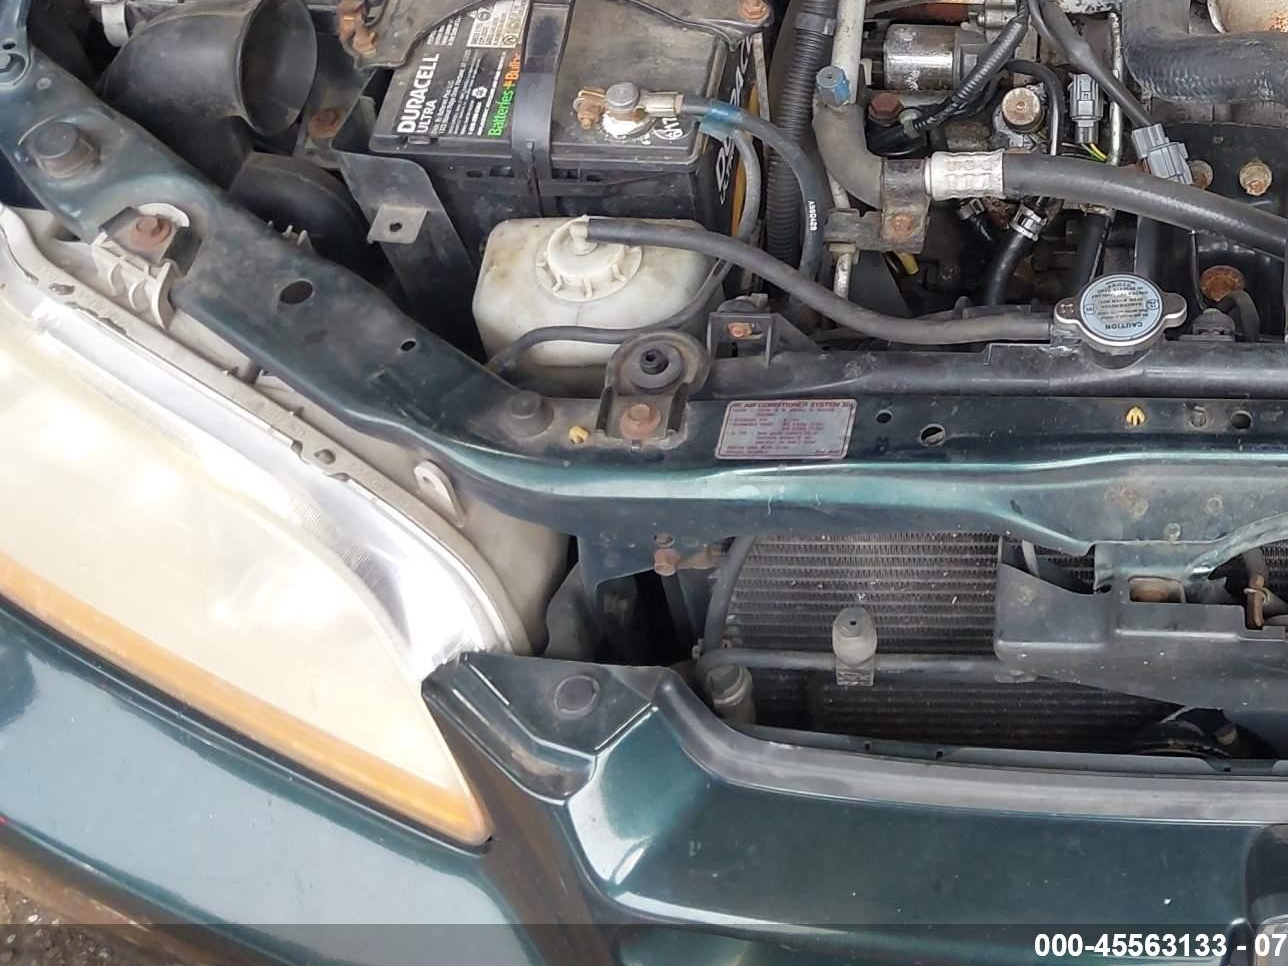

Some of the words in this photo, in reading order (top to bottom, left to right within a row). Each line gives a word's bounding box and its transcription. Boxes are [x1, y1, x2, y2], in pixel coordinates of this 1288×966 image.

[397, 53, 440, 133] DURACELL
[416, 99, 437, 133] ULTRA
[1105, 321, 1143, 330] CAUTION
